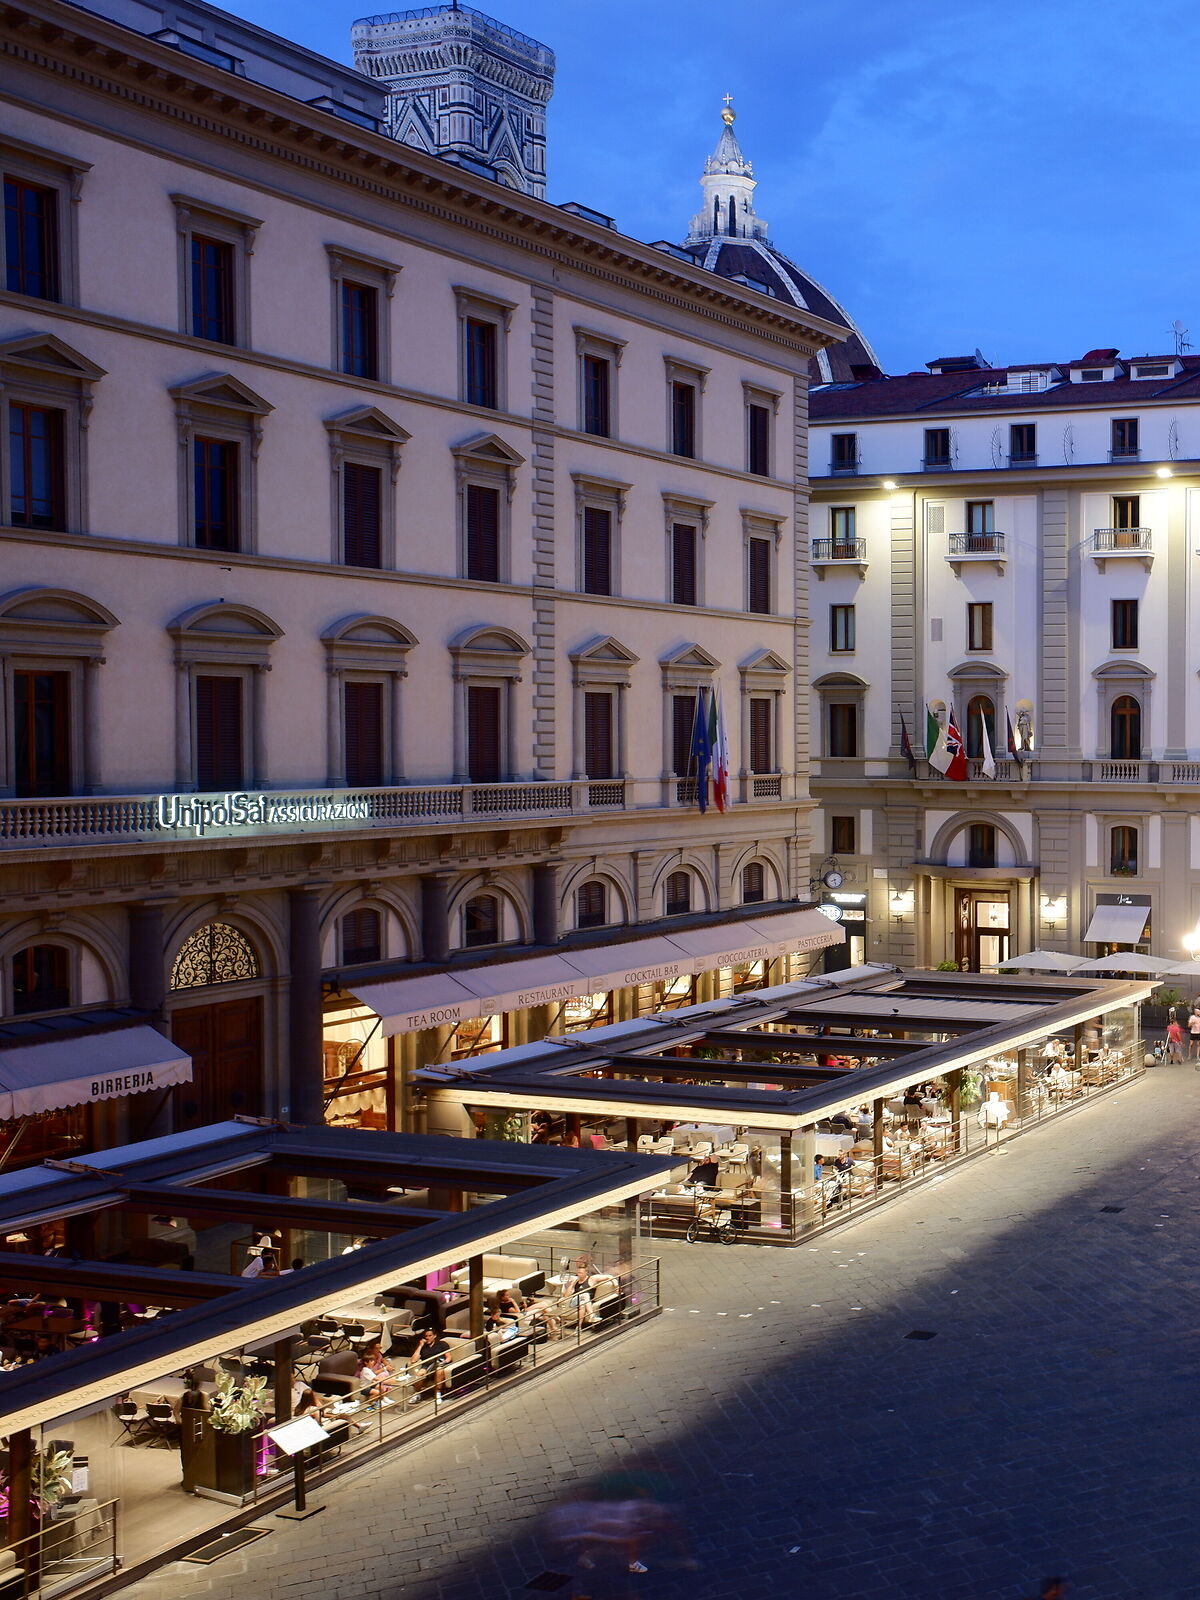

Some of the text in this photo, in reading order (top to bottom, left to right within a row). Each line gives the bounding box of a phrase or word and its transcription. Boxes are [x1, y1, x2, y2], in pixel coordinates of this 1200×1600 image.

[797, 935, 833, 949] PASTICCERIA
[717, 948, 769, 965] CIOCCOLATERIA
[624, 965, 679, 984] COCKTAIL BAR
[518, 985, 575, 1005] RESTAURANT
[407, 1008, 461, 1028] TEA ROOM
[91, 1072, 154, 1096] BIRRERIA
